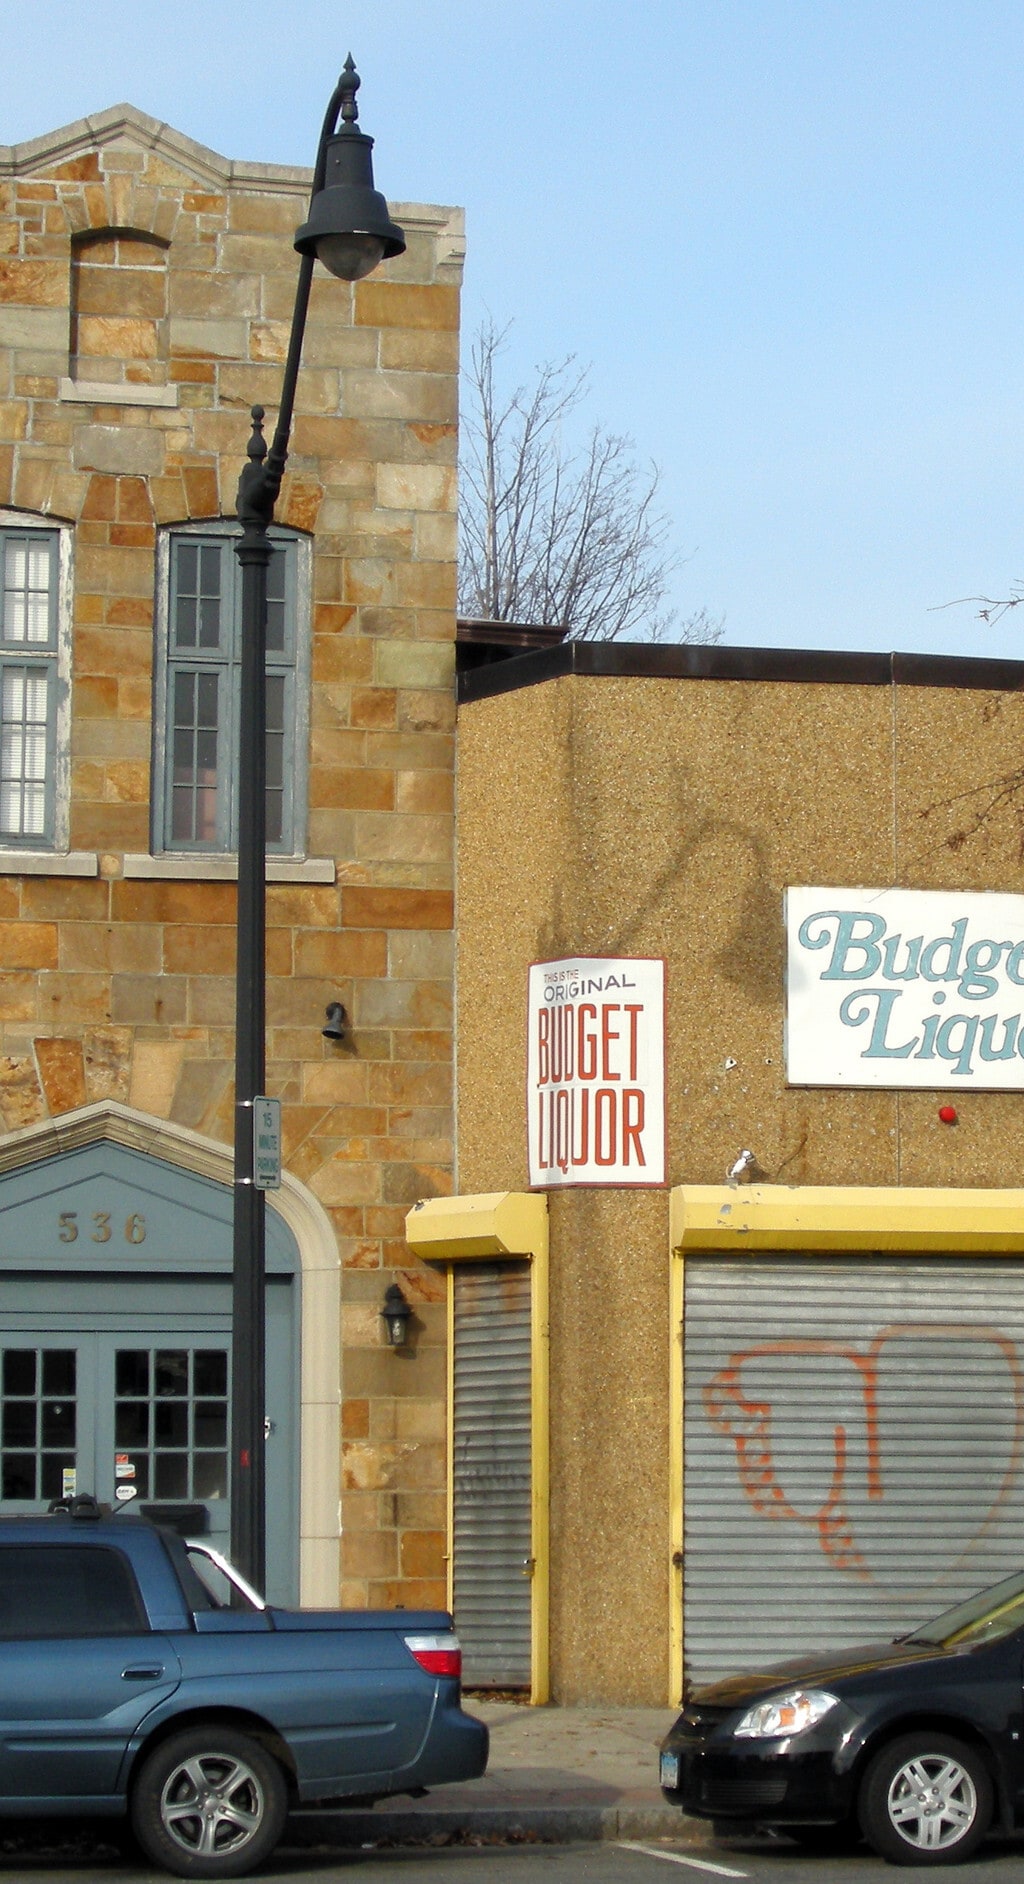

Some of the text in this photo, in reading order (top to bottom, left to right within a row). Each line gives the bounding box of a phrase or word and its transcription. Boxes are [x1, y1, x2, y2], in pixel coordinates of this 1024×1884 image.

[544, 973, 558, 984] THIS
[567, 969, 580, 980] THE
[544, 973, 637, 1002] ORIGINAL
[538, 1003, 644, 1085] BUDGET
[263, 1112, 273, 1128] 15
[538, 1088, 647, 1175] LIQUOR
[58, 1212, 147, 1244] 536
